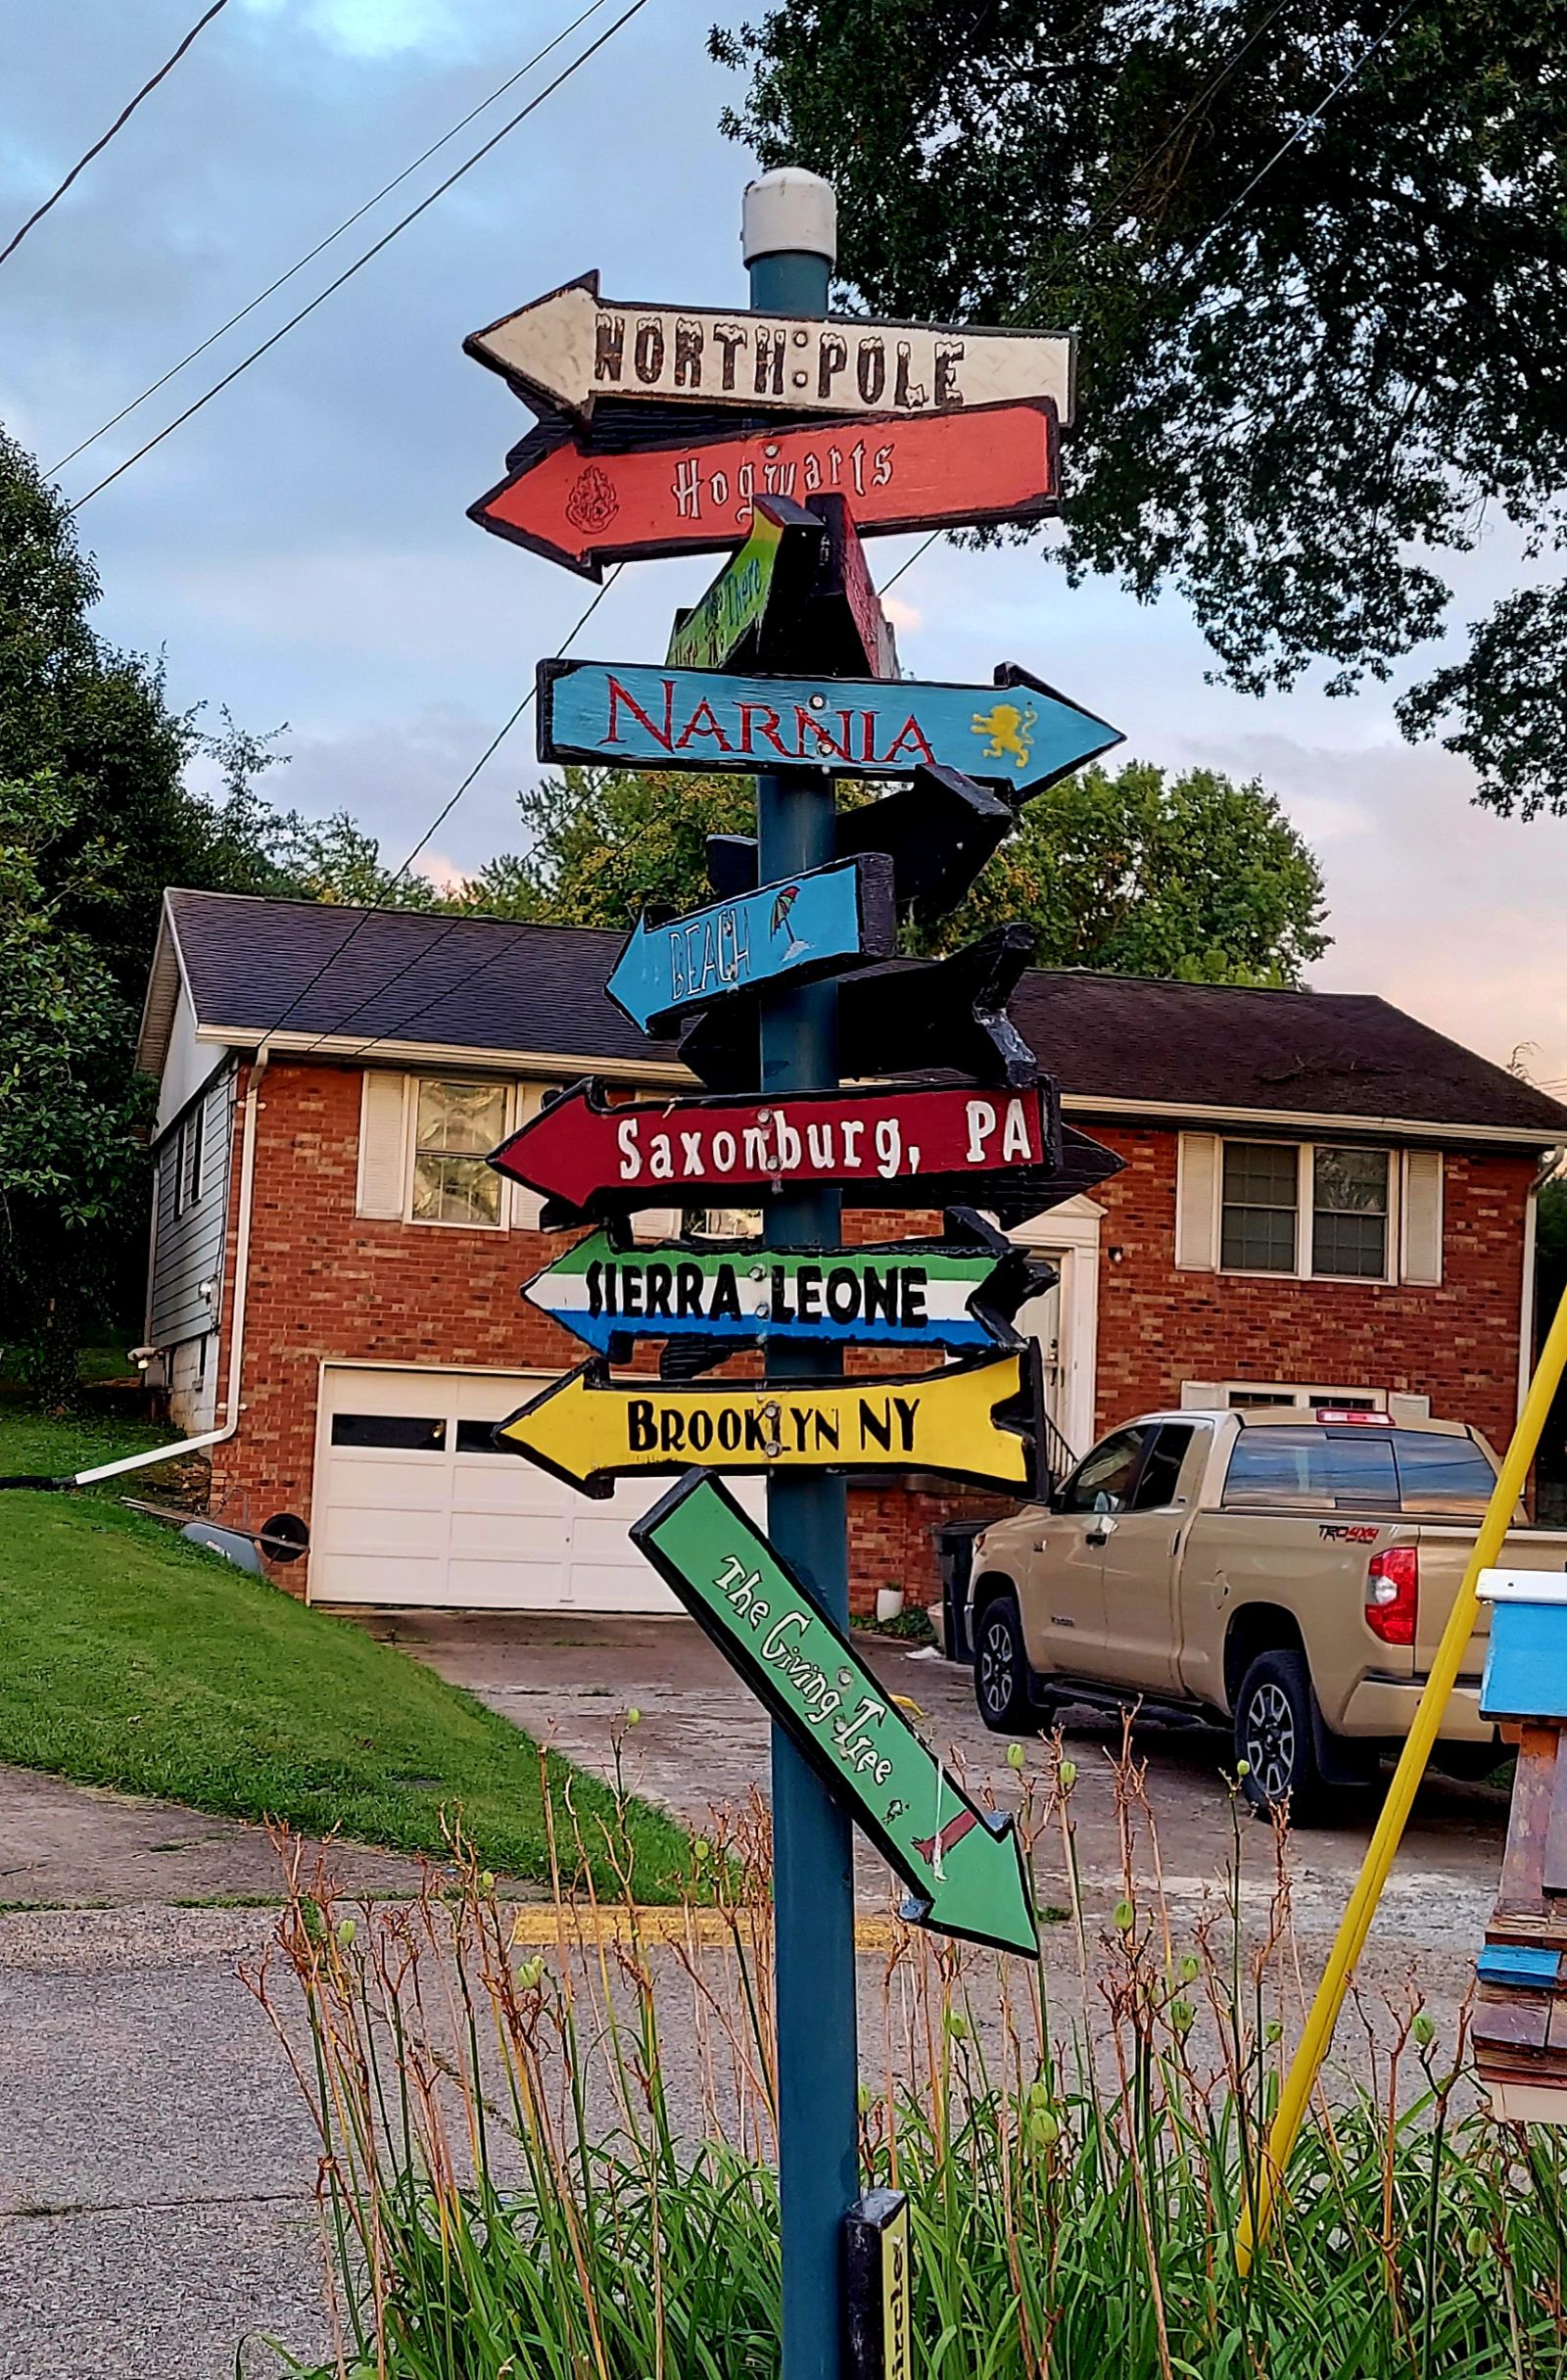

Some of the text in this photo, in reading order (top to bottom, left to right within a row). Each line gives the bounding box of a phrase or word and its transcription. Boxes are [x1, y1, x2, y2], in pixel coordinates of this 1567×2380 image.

[594, 312, 965, 407] NORTH POLE
[672, 438, 895, 522] Hogwarts
[598, 673, 936, 765] NARNIA
[668, 907, 751, 1002] BEACH
[617, 1098, 1032, 1179] Saxonburg, PA
[586, 1262, 929, 1328] SIERRA LEONE
[859, 1397, 922, 1453] NY
[711, 1555, 893, 1785] The Giving Tree
[888, 2243, 905, 2380] ircle
